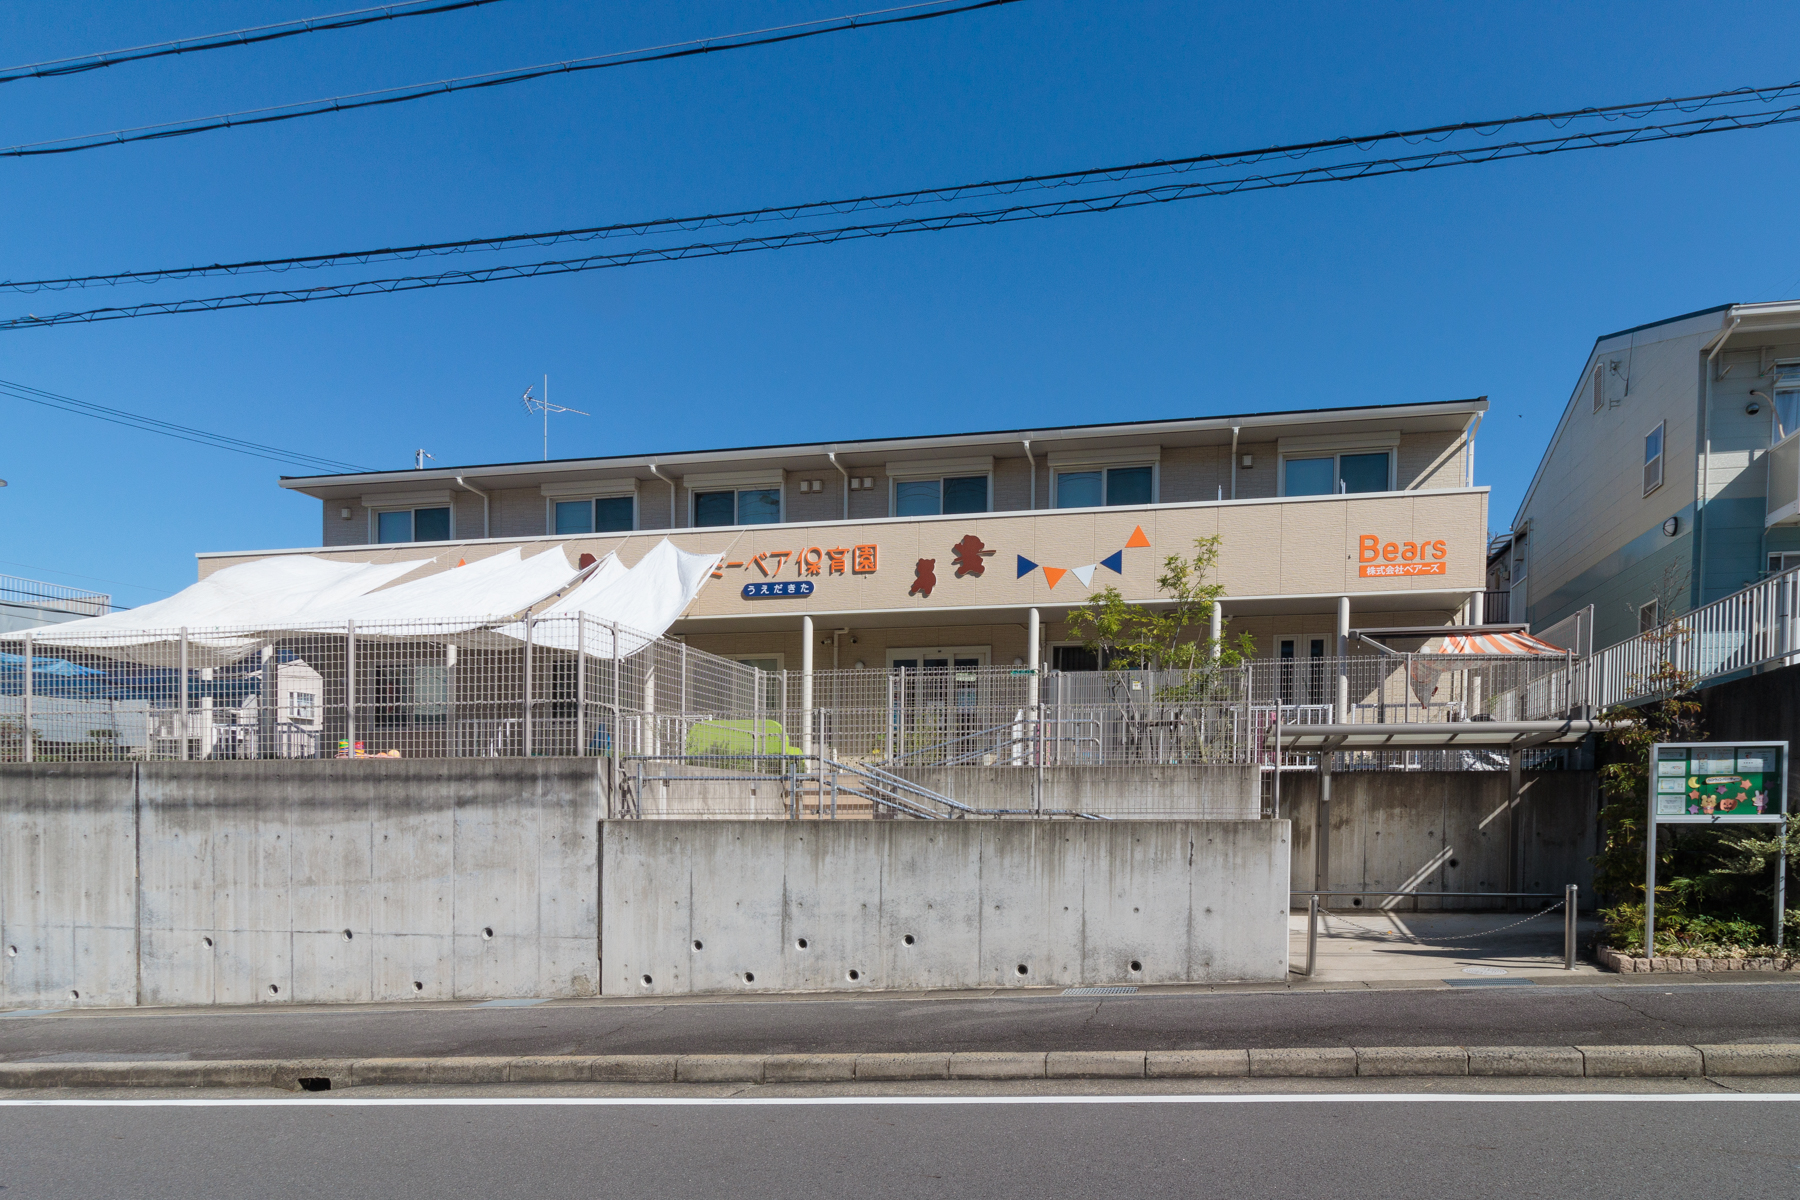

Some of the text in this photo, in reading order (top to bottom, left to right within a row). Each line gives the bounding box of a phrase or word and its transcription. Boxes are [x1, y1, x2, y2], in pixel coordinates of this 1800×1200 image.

[1359, 534, 1447, 562] Bears
[1366, 563, 1440, 576] 株式会社ベアーズ
[747, 584, 810, 595] うえだきた
